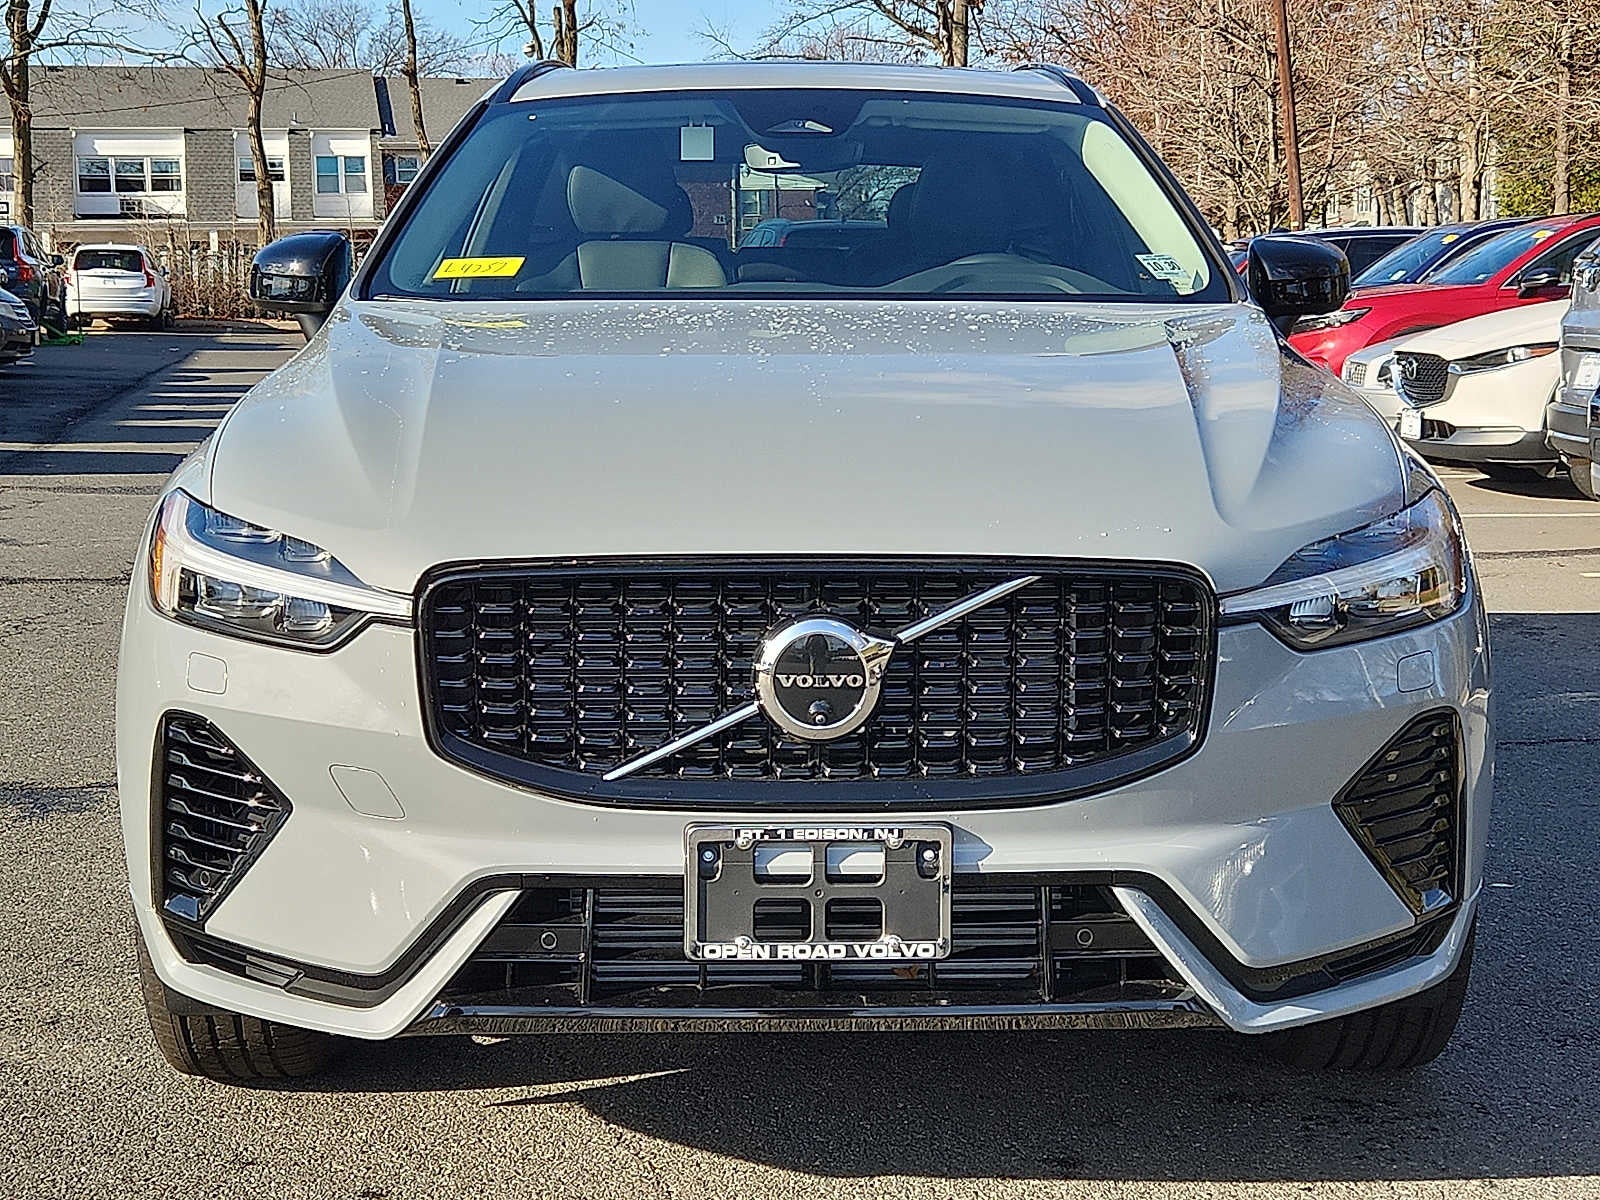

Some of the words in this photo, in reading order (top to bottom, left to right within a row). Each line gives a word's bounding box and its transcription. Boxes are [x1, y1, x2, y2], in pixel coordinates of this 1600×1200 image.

[1146, 261, 1165, 272] 10
[776, 674, 864, 688] VOLVO
[776, 828, 786, 840] 1
[793, 828, 868, 840] EDISON,
[874, 828, 899, 840] NJ
[703, 944, 773, 960] OPEN
[777, 944, 847, 960] ROAD
[853, 943, 937, 959] VOLVO
